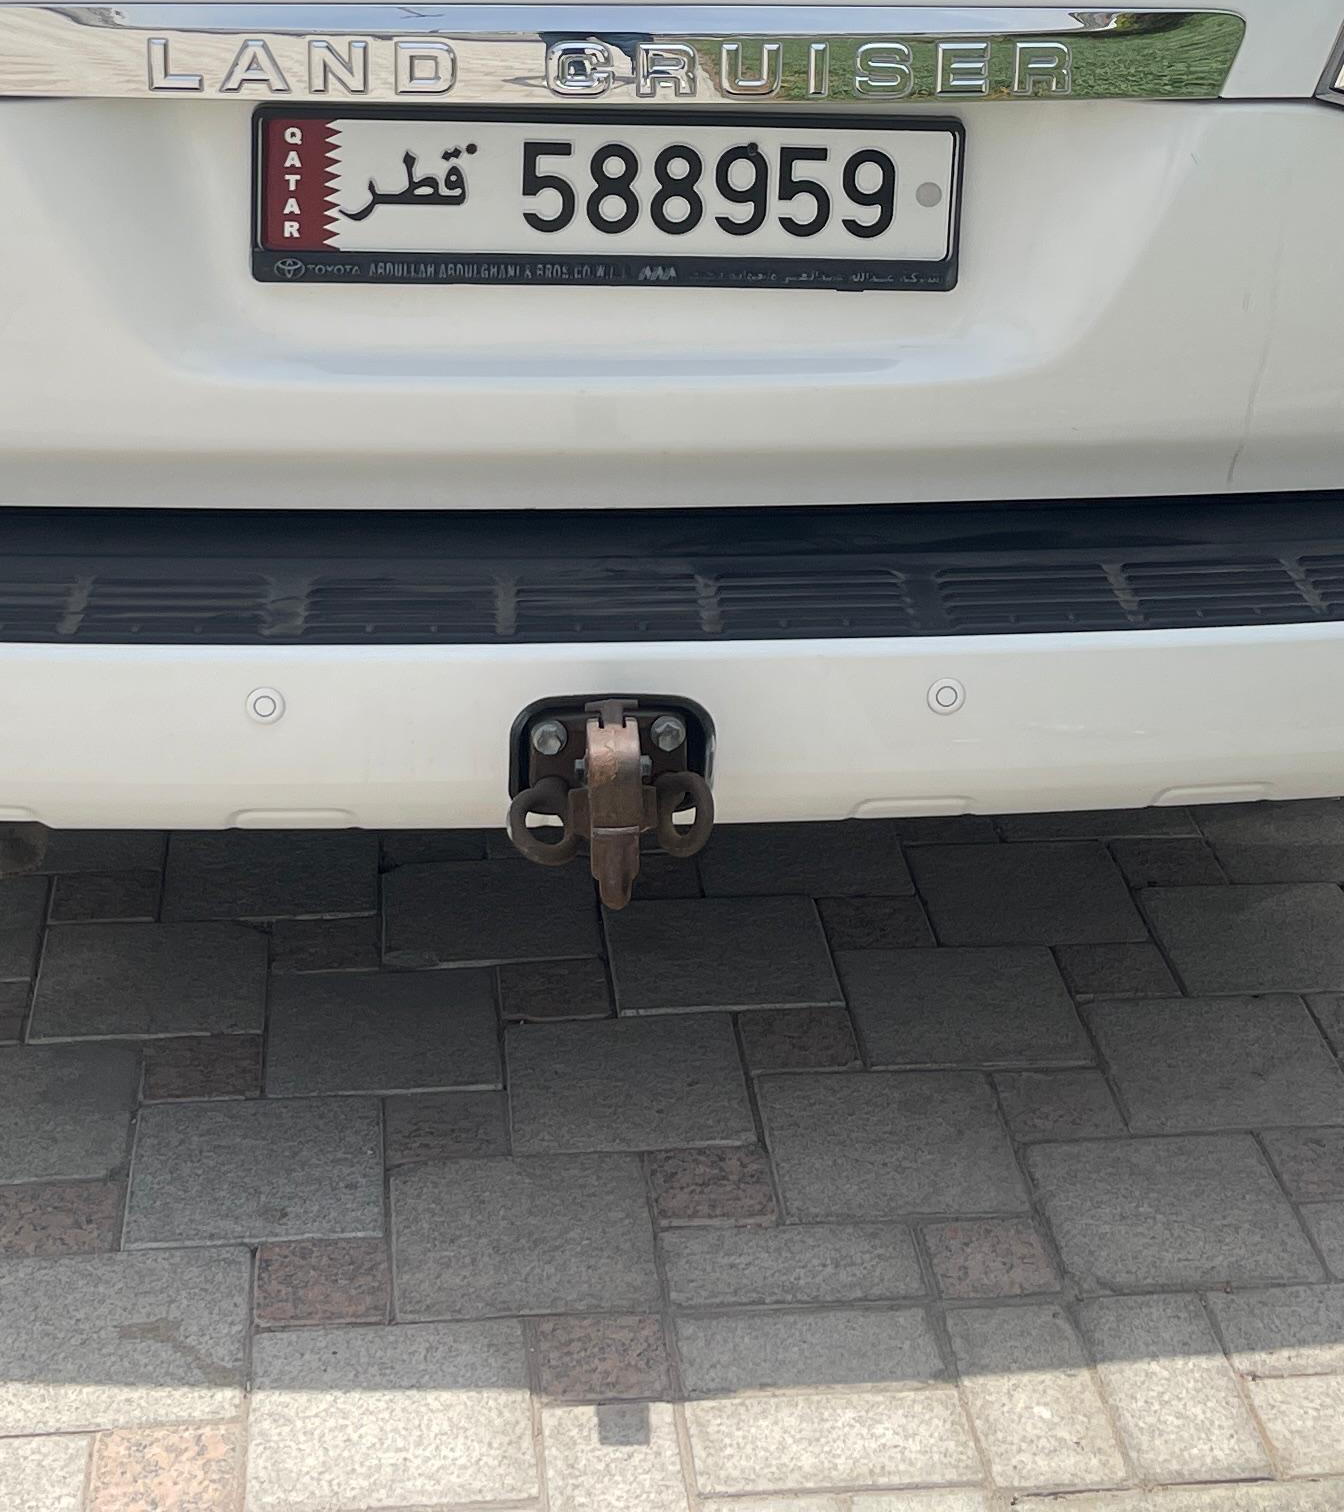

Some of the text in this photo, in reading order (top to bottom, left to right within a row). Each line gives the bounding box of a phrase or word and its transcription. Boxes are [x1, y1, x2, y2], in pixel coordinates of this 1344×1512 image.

[148, 37, 1074, 97] LAND CRUISER
[283, 126, 303, 238] QATAR
[338, 147, 467, 221] قطر
[522, 141, 896, 239] 588959
[307, 264, 361, 275] TOYOTA
